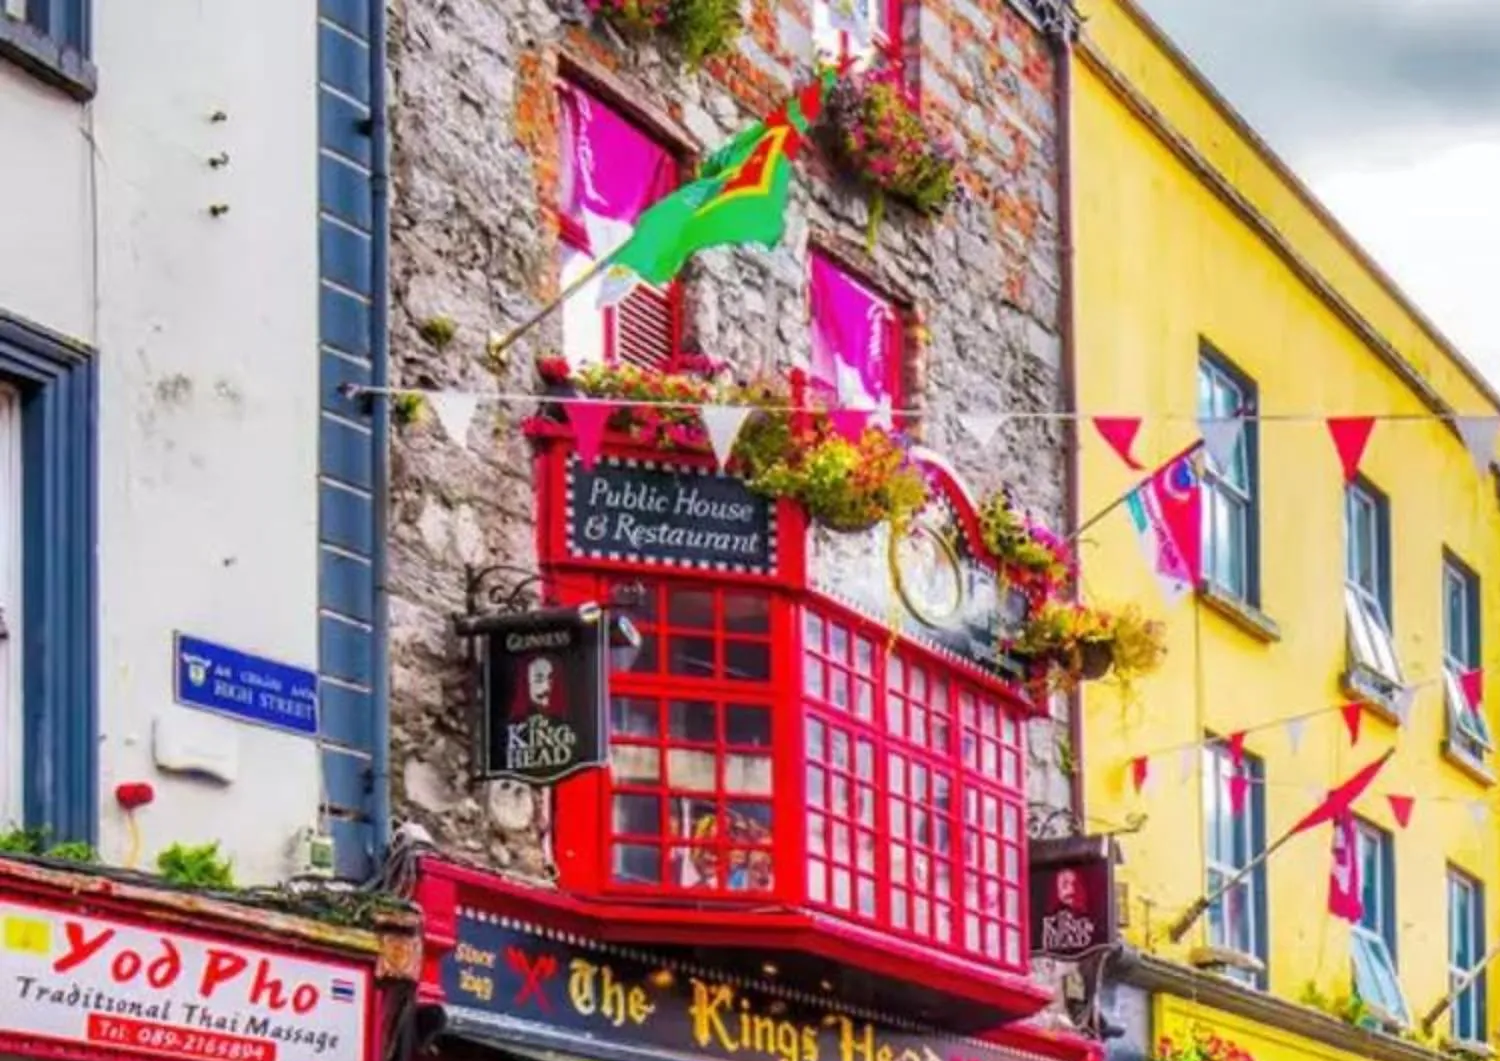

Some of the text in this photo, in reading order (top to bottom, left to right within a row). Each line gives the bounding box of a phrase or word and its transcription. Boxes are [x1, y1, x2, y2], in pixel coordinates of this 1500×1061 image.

[588, 476, 755, 523] Public House
[584, 511, 761, 555] & Restaurant
[213, 679, 313, 721] HIGH STREET
[506, 748, 572, 770] HEAD
[198, 948, 322, 1015] Pho
[568, 957, 655, 1027] The
[15, 975, 341, 1054] Traditional Thai Massage
